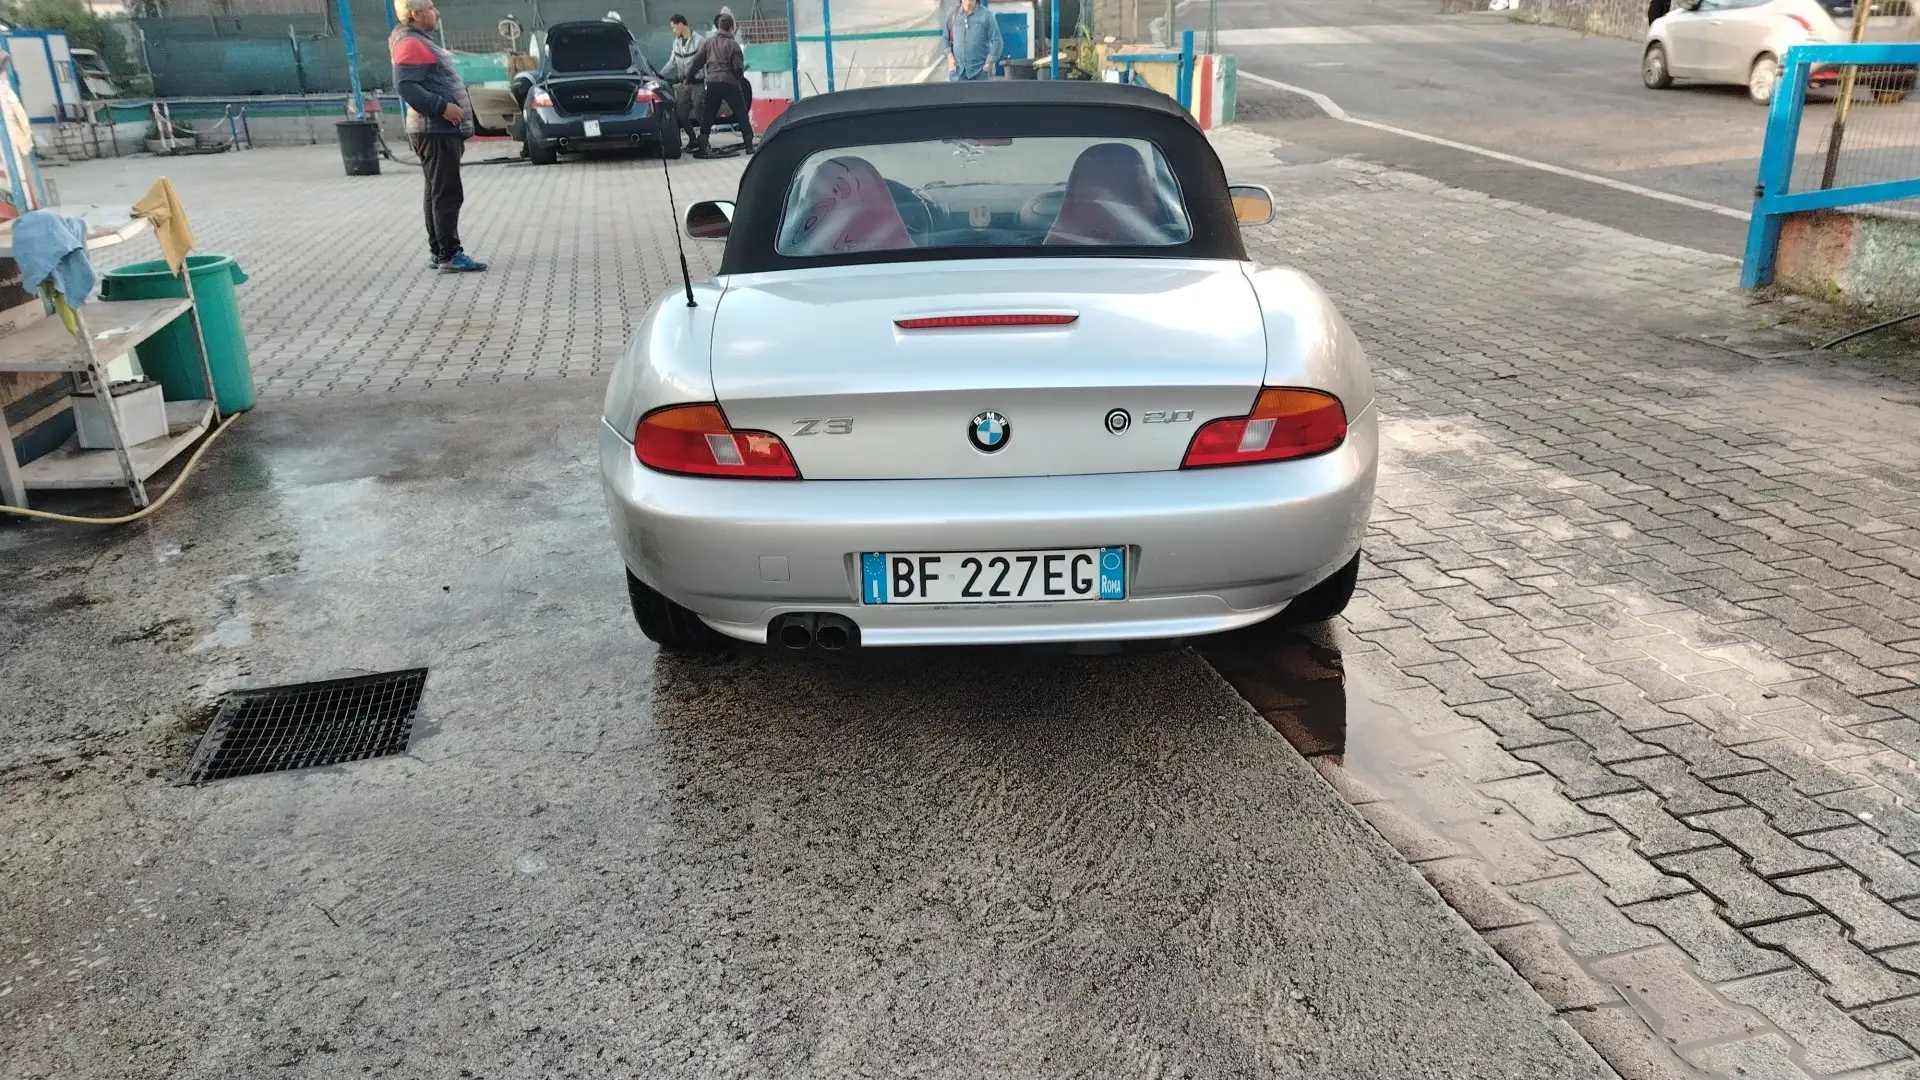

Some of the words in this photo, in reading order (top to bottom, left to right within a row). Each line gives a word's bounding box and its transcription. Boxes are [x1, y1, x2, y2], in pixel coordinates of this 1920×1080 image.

[790, 416, 854, 436] Z3
[973, 412, 1007, 426] BMW
[892, 556, 941, 598] BF
[960, 554, 1093, 597] 227EG
